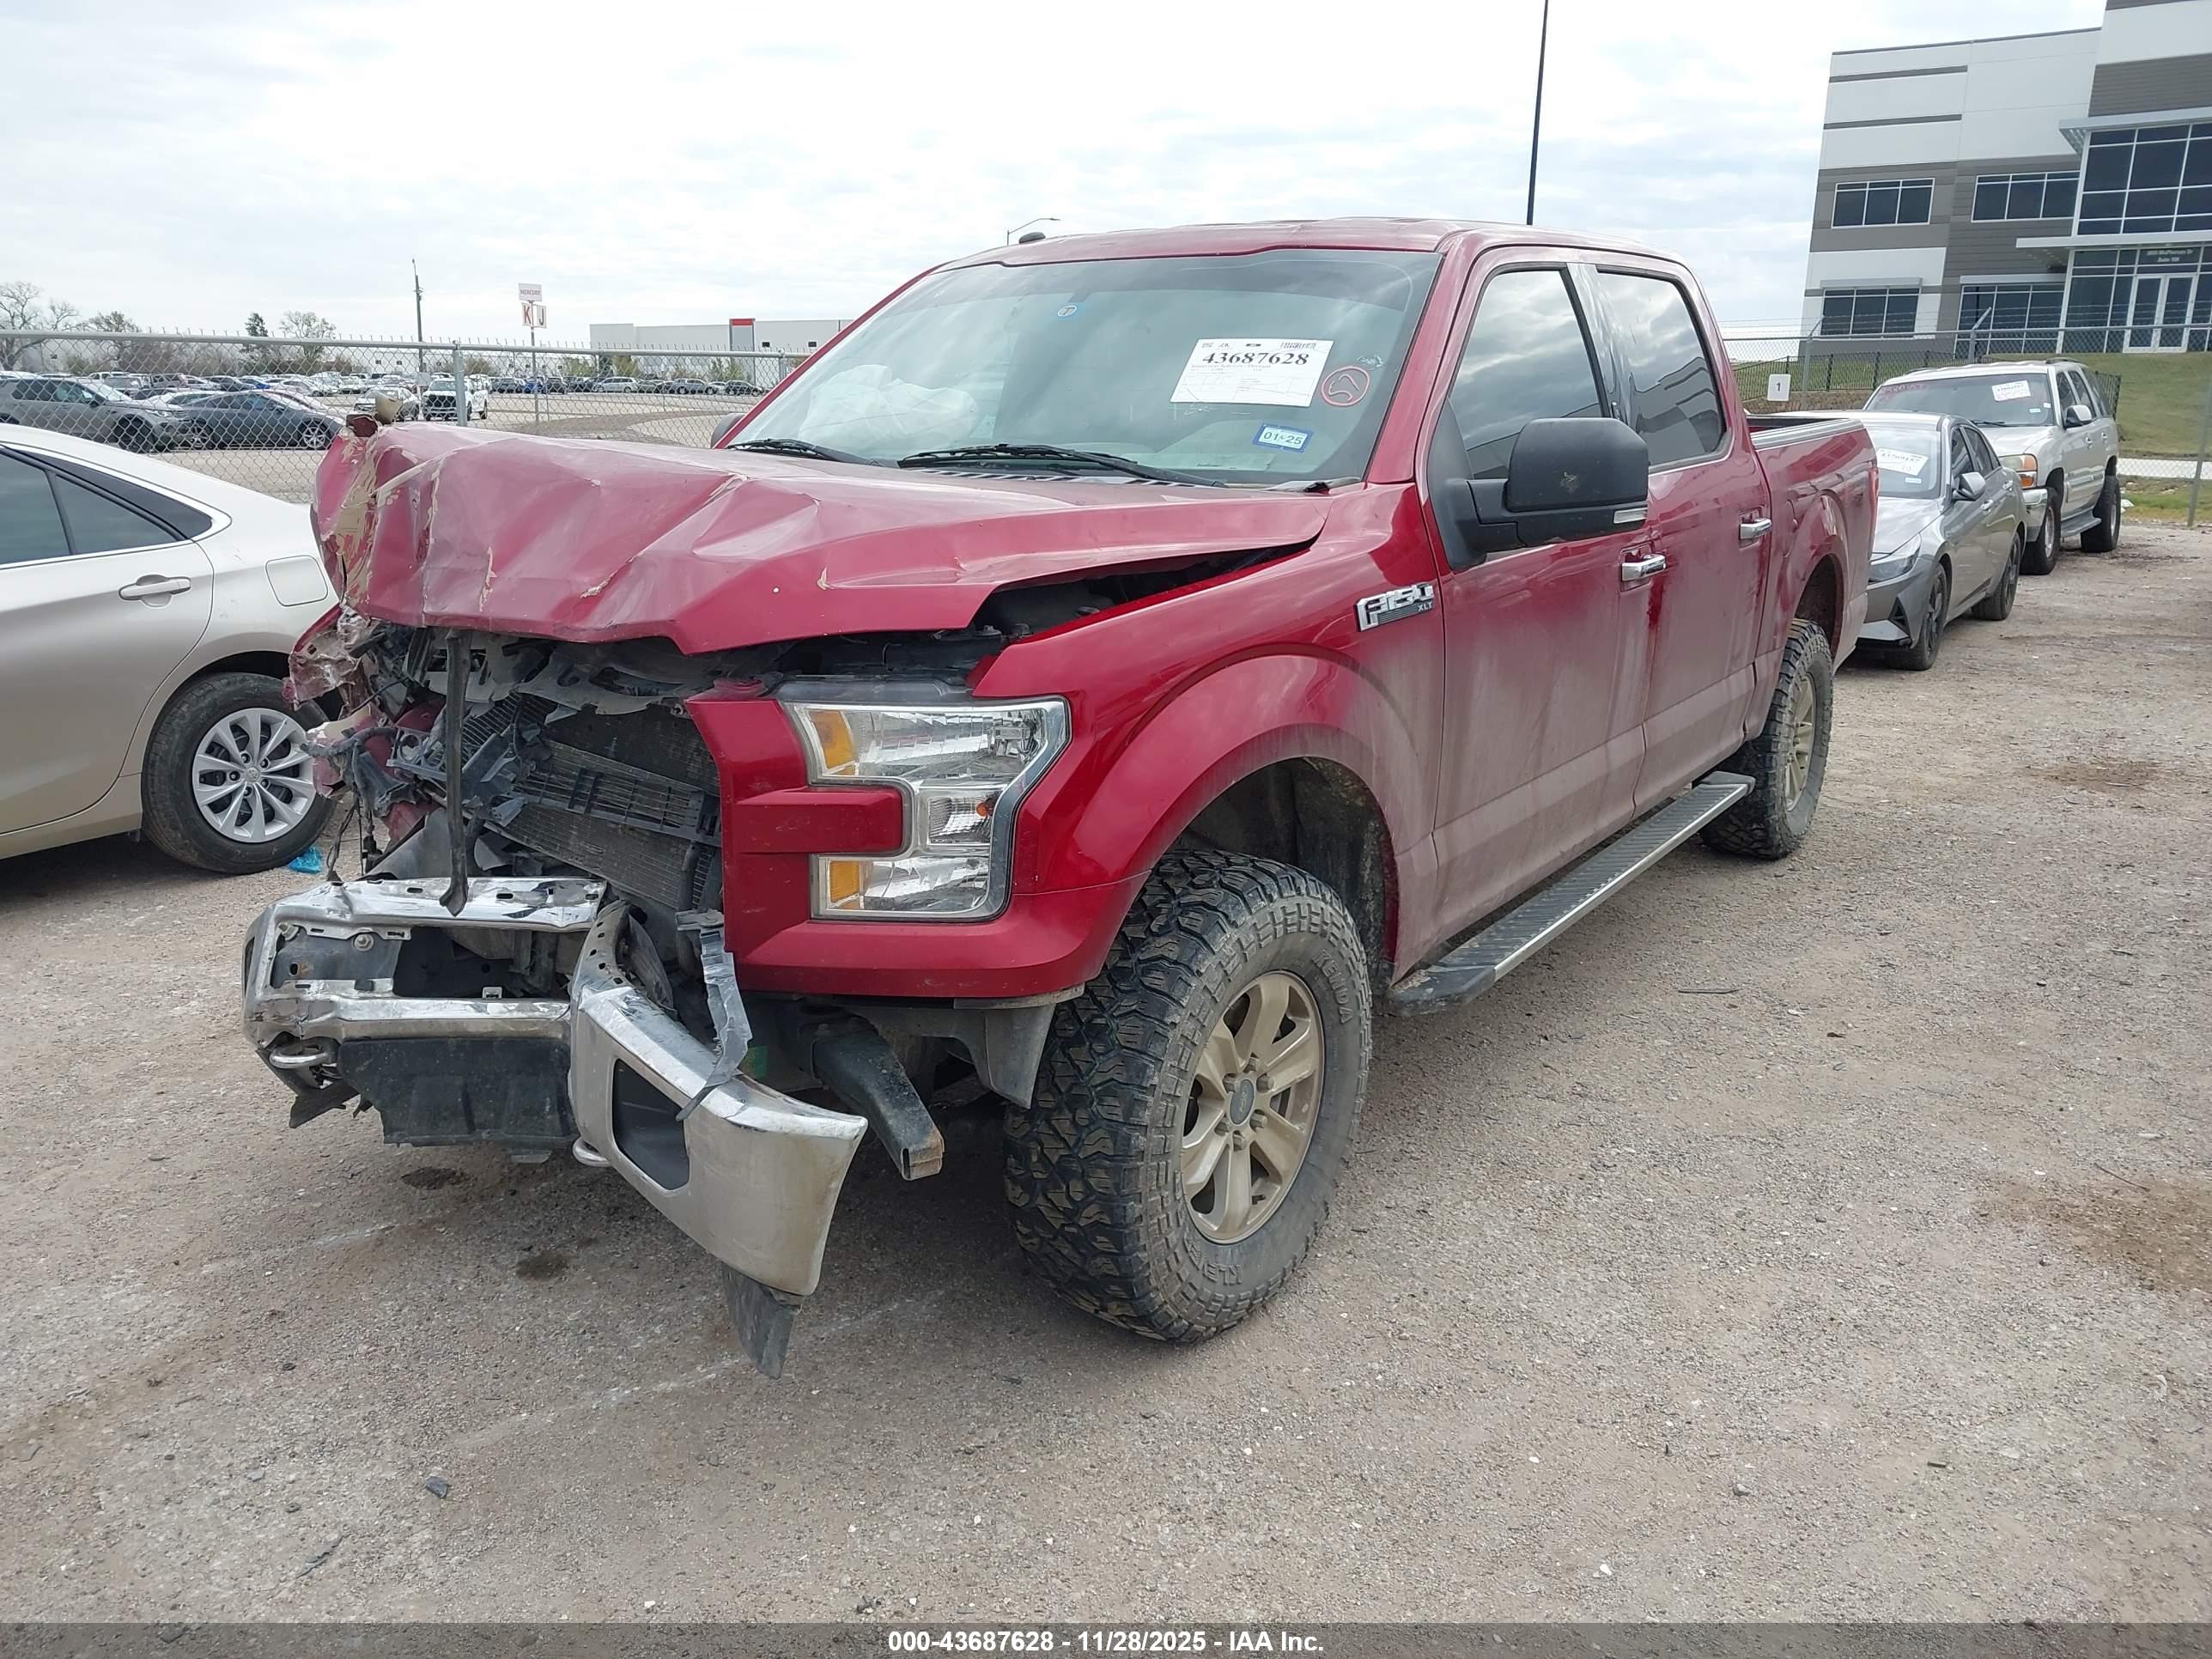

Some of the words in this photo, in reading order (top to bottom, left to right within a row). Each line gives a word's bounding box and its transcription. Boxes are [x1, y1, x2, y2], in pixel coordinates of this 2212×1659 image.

[524, 305, 532, 324] K
[539, 308, 544, 325] J
[1202, 352, 1309, 365] 43687628
[1777, 382, 1781, 392] 1
[1263, 431, 1279, 441] 01
[1285, 435, 1303, 446] 25
[1417, 602, 1432, 611] XLT
[1310, 949, 1353, 1024] KENDA
